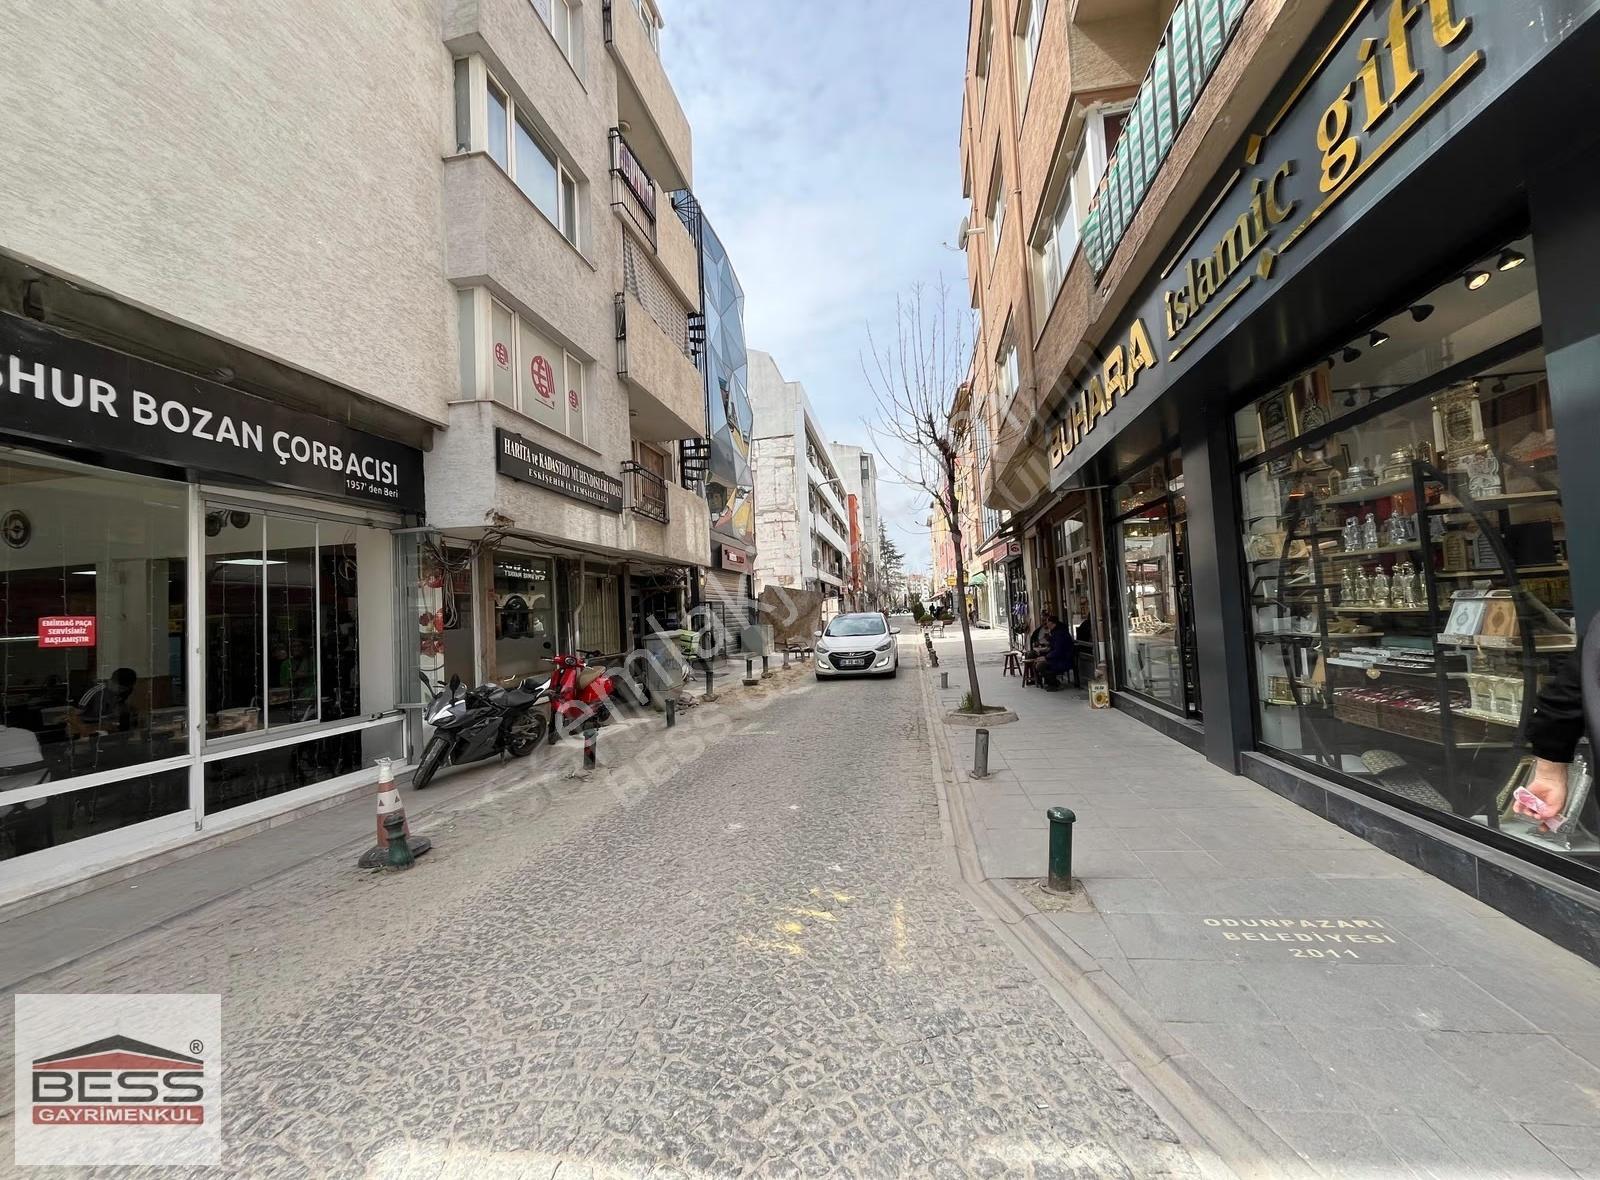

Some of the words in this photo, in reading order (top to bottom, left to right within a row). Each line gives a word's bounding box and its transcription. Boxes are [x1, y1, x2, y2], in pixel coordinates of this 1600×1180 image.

[1048, 318, 1157, 469] BUHARA
[1164, 159, 1299, 343] islamic
[1317, 0, 1470, 193] gift
[0, 353, 119, 419] HUR
[132, 389, 264, 453] BOZAN
[272, 430, 399, 486] ÇORBACISI
[503, 438, 531, 463] HARİTA
[531, 452, 539, 466] ve
[539, 452, 571, 479] KADASTRO
[368, 483, 383, 495] den
[383, 487, 399, 499] Beri
[75, 619, 93, 628] PAÇA
[1202, 918, 1386, 929] ODUNPAZARI
[1222, 931, 1398, 944] BELEDİYESİ
[1287, 948, 1361, 959] 2011
